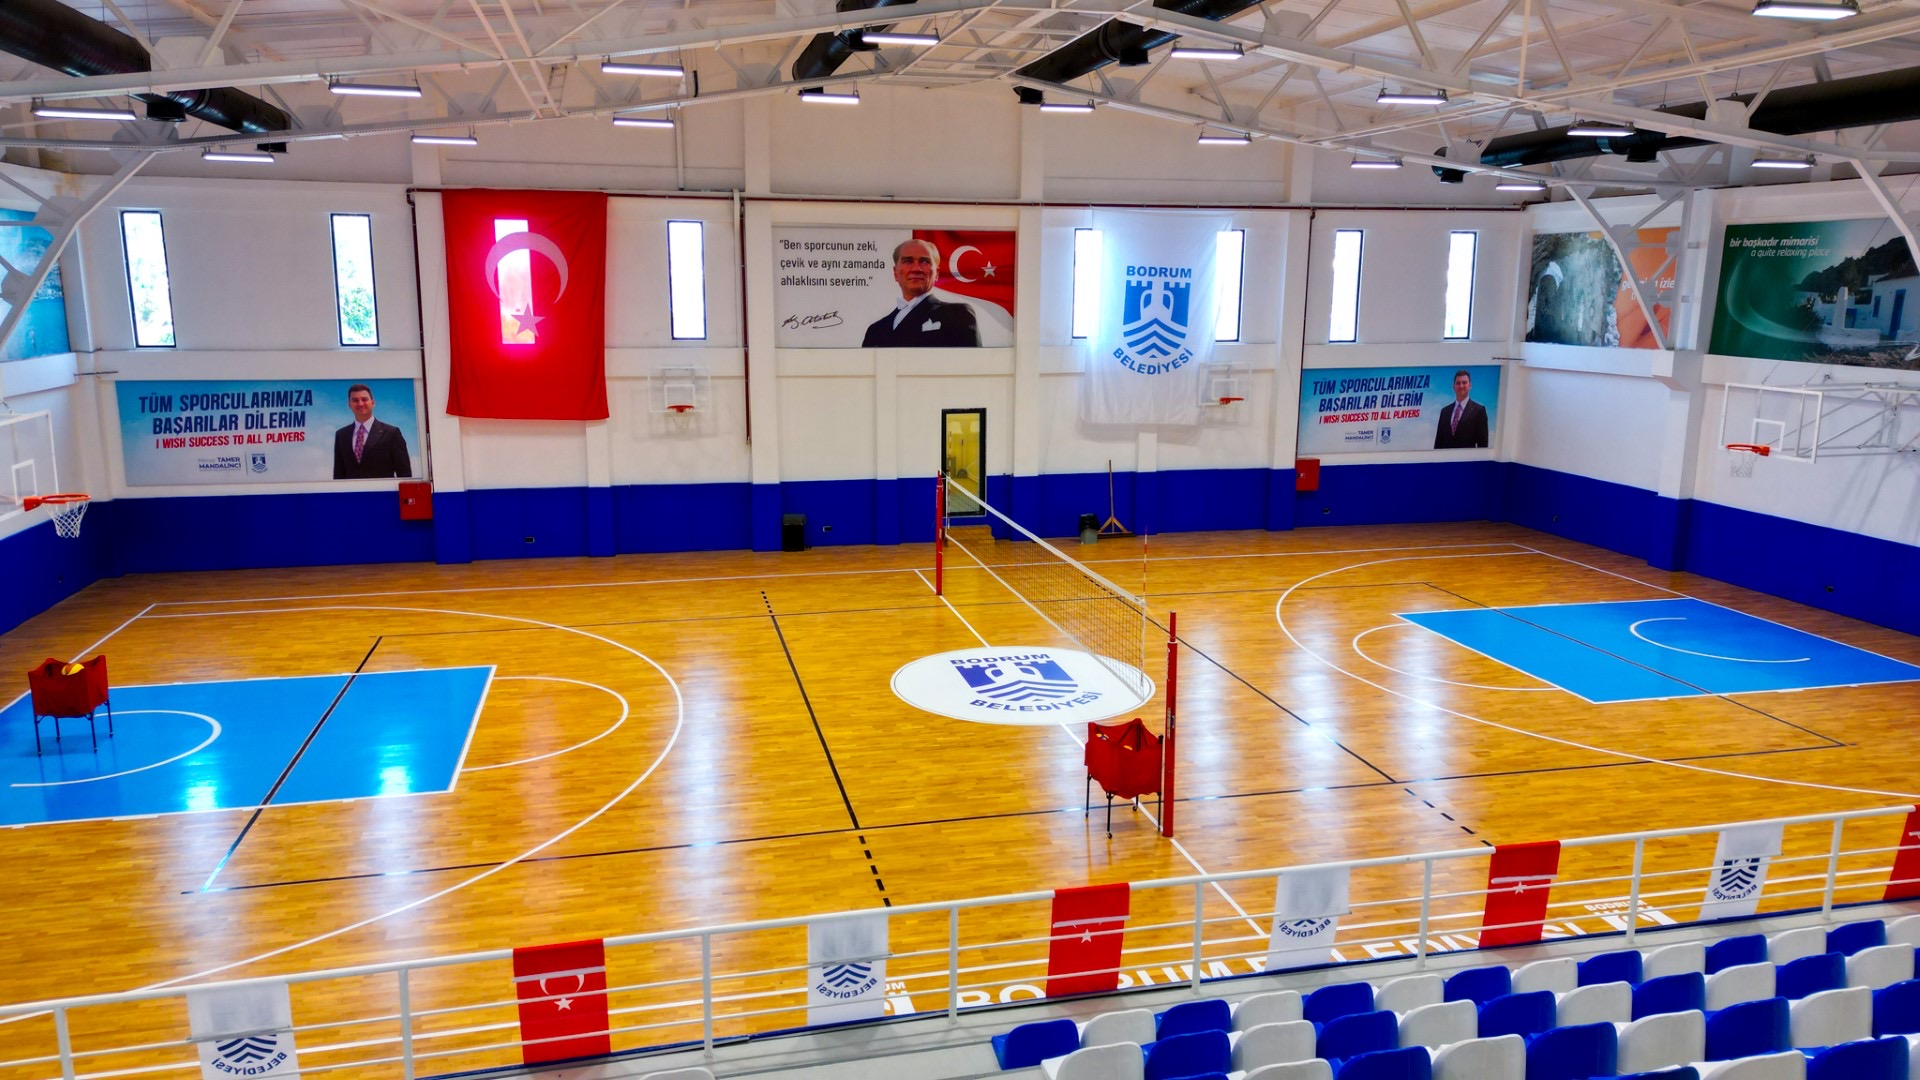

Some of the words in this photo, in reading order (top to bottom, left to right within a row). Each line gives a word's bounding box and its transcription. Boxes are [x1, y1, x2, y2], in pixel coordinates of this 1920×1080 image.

[804, 241, 854, 252] sporcunun
[856, 240, 878, 252] zeki,
[1729, 237, 1742, 247] bir
[1780, 235, 1820, 246] mimarisi
[1757, 248, 1776, 258] quite
[1776, 247, 1807, 258] relaxing
[1807, 247, 1831, 258] place
[780, 258, 805, 270] çevik
[808, 260, 819, 268] ve
[821, 260, 841, 271] aynı
[843, 259, 886, 269] zamanda
[1126, 265, 1192, 279] BODRUM
[780, 275, 828, 286] ahlaklısını
[1112, 347, 1194, 375] BELEDİYESİ
[1312, 377, 1337, 395] TÜM
[1339, 374, 1431, 394] SPORCULARIMIZA
[138, 392, 173, 413] TÜM
[179, 389, 313, 412] SPORCULARIMIZA
[1318, 394, 1378, 412] BAŞARILAR
[1380, 390, 1424, 408] DİLERİM
[152, 414, 239, 436] BAŞARILAR
[244, 407, 306, 430] DİLERİM
[1323, 414, 1340, 424] WISH
[1340, 412, 1370, 423] SUCCESS
[1370, 412, 1379, 421] TO
[1380, 411, 1391, 420] ALL
[1392, 409, 1421, 419] PLAYERS
[155, 437, 159, 449] I
[162, 437, 186, 449] WISH
[188, 435, 230, 447] SUCCESS
[232, 434, 244, 445] TO
[246, 433, 263, 444] ALL
[266, 431, 305, 444] PLAYERS
[949, 653, 1051, 665] BODRUM
[969, 690, 1105, 712] BELEDİYESİ
